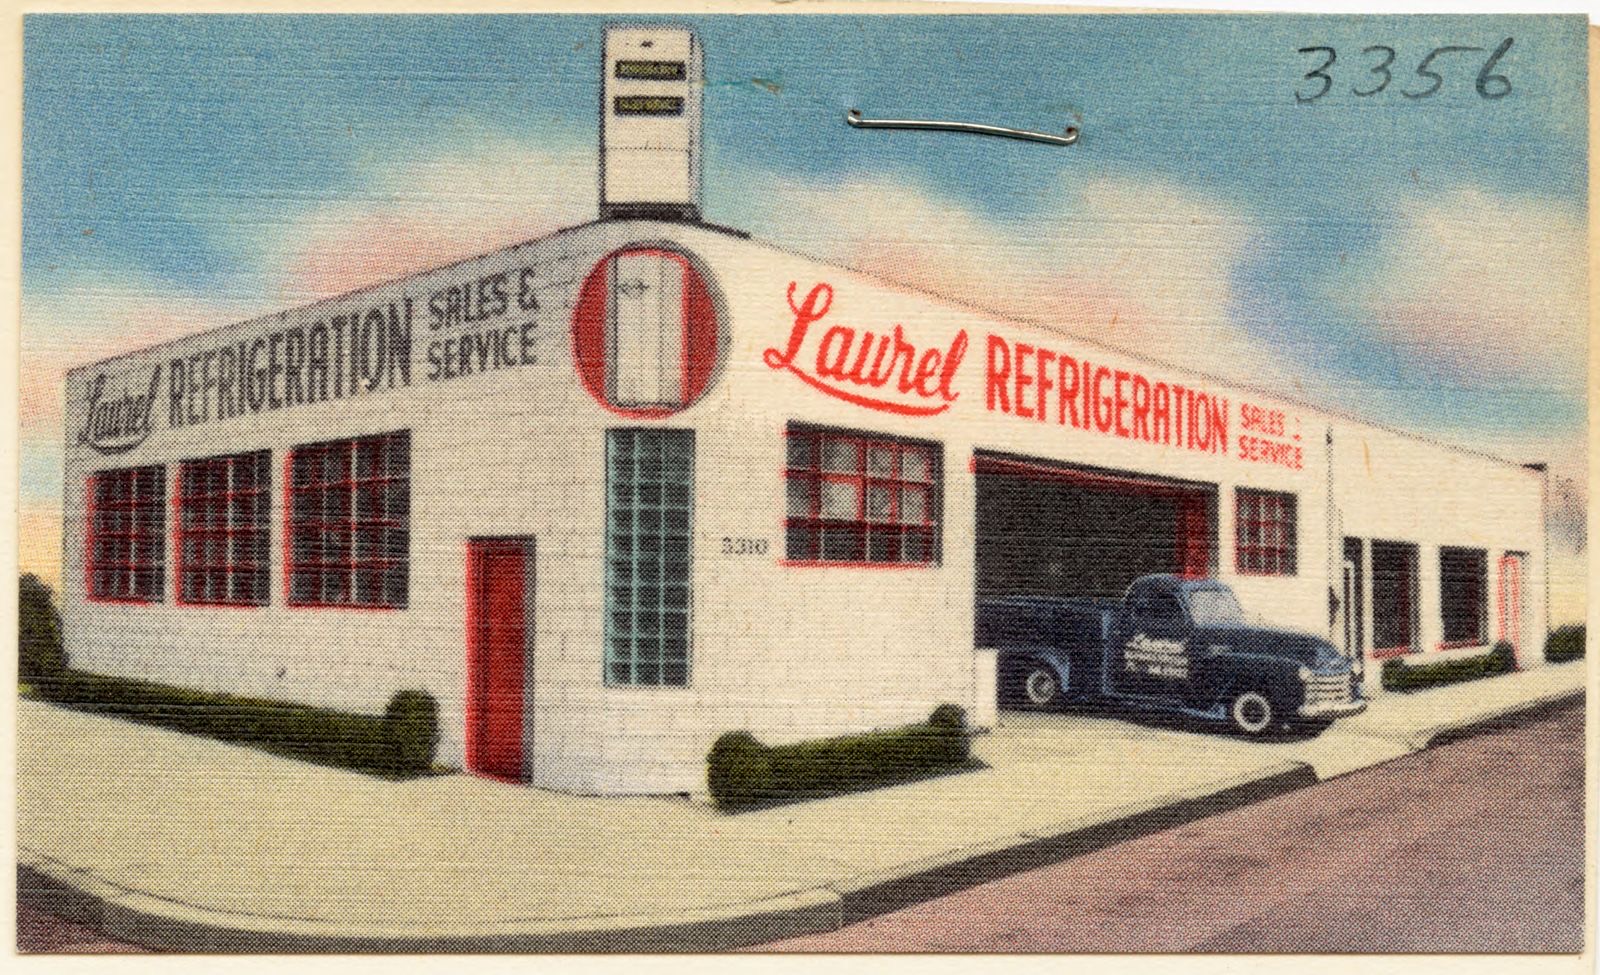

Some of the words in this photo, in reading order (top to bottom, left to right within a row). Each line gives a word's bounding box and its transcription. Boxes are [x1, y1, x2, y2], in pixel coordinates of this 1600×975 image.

[1295, 37, 1514, 102] 3356
[428, 272, 508, 331] SALES
[517, 268, 541, 312] &
[77, 362, 161, 455] Laurel
[168, 298, 413, 429] REFRIGERATION
[426, 321, 538, 382] SERVICE
[763, 280, 969, 417] Laurel
[985, 331, 1229, 455] REFRIGERATION
[1240, 403, 1286, 437] SALES
[1238, 434, 1303, 471] SERVICE
